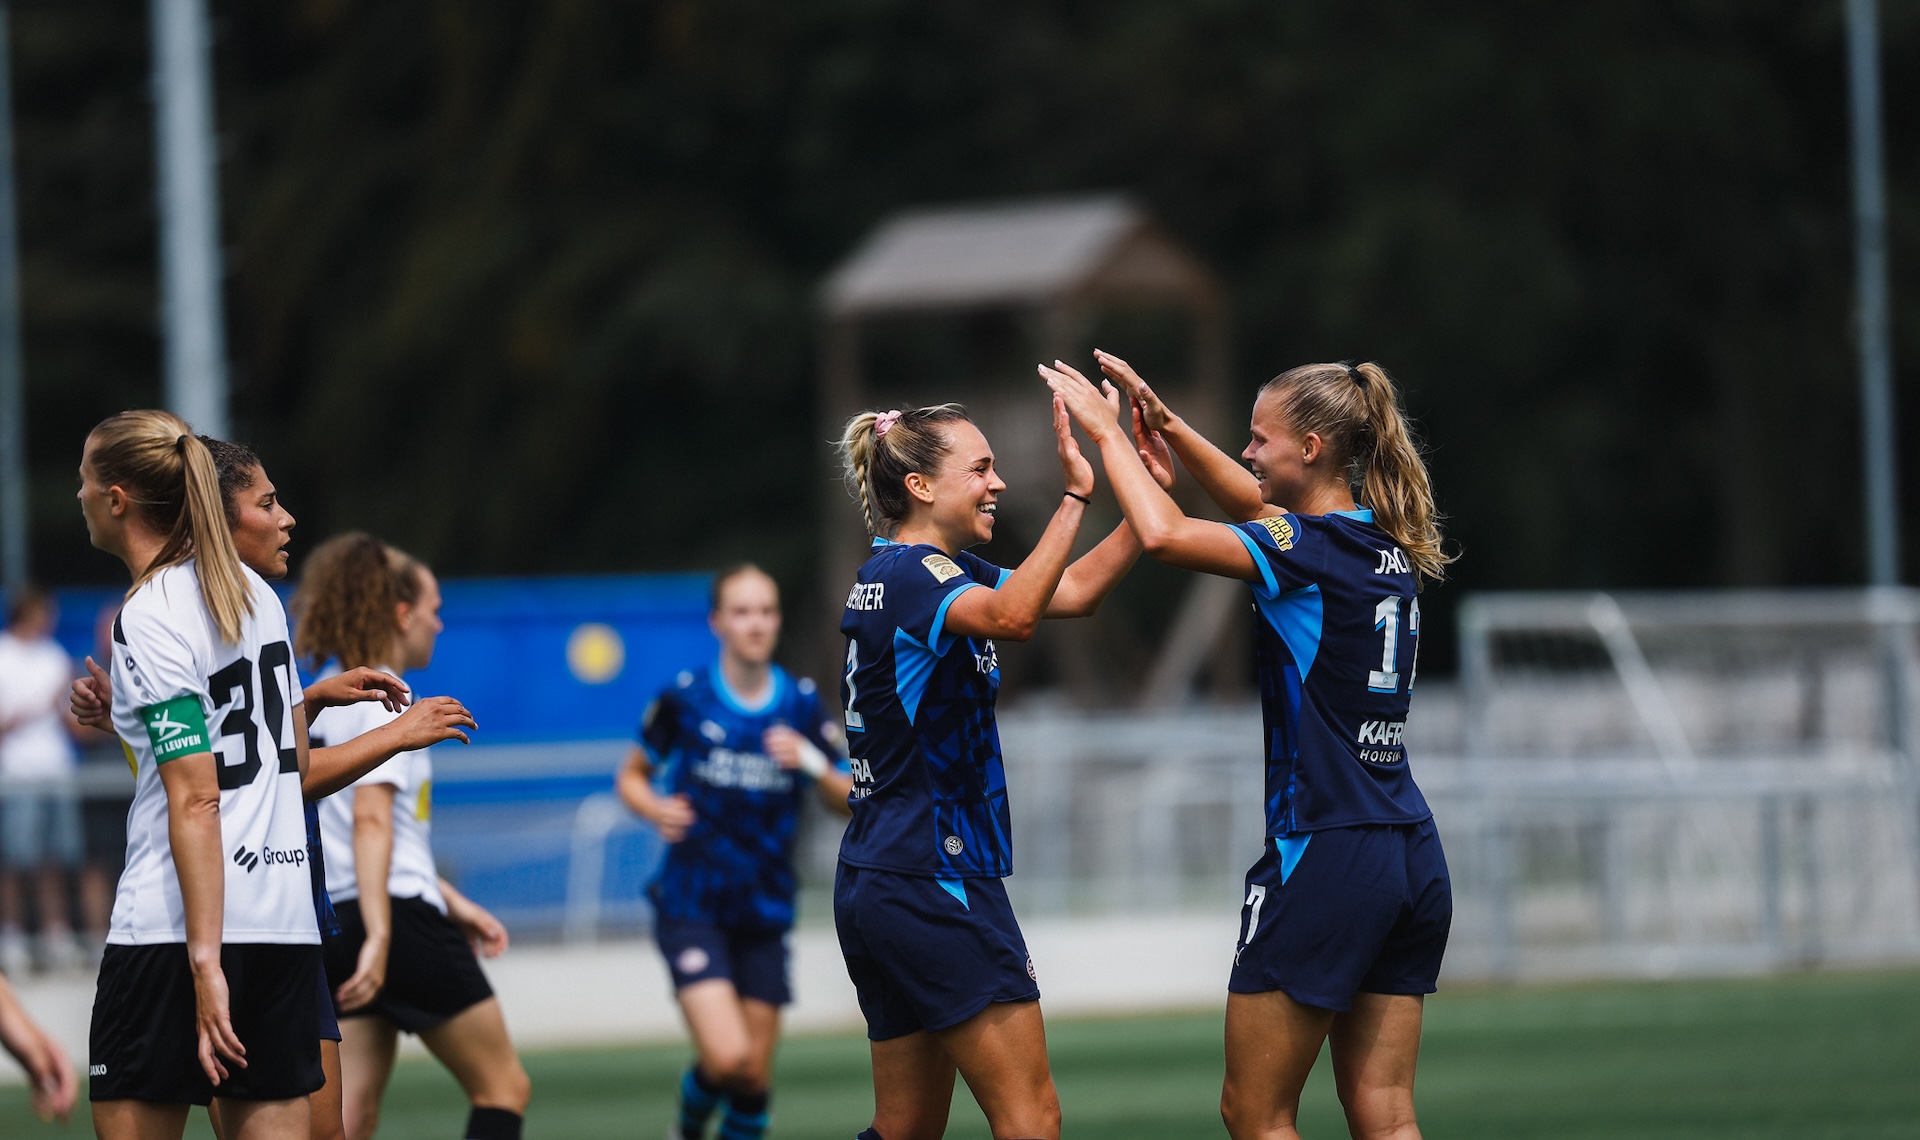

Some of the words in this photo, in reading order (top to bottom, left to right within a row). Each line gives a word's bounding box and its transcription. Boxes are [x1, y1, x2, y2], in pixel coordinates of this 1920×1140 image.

[208, 641, 301, 790] 30
[164, 734, 202, 753] LEUVEN
[1358, 720, 1405, 746] KAFR
[263, 846, 305, 867] Group
